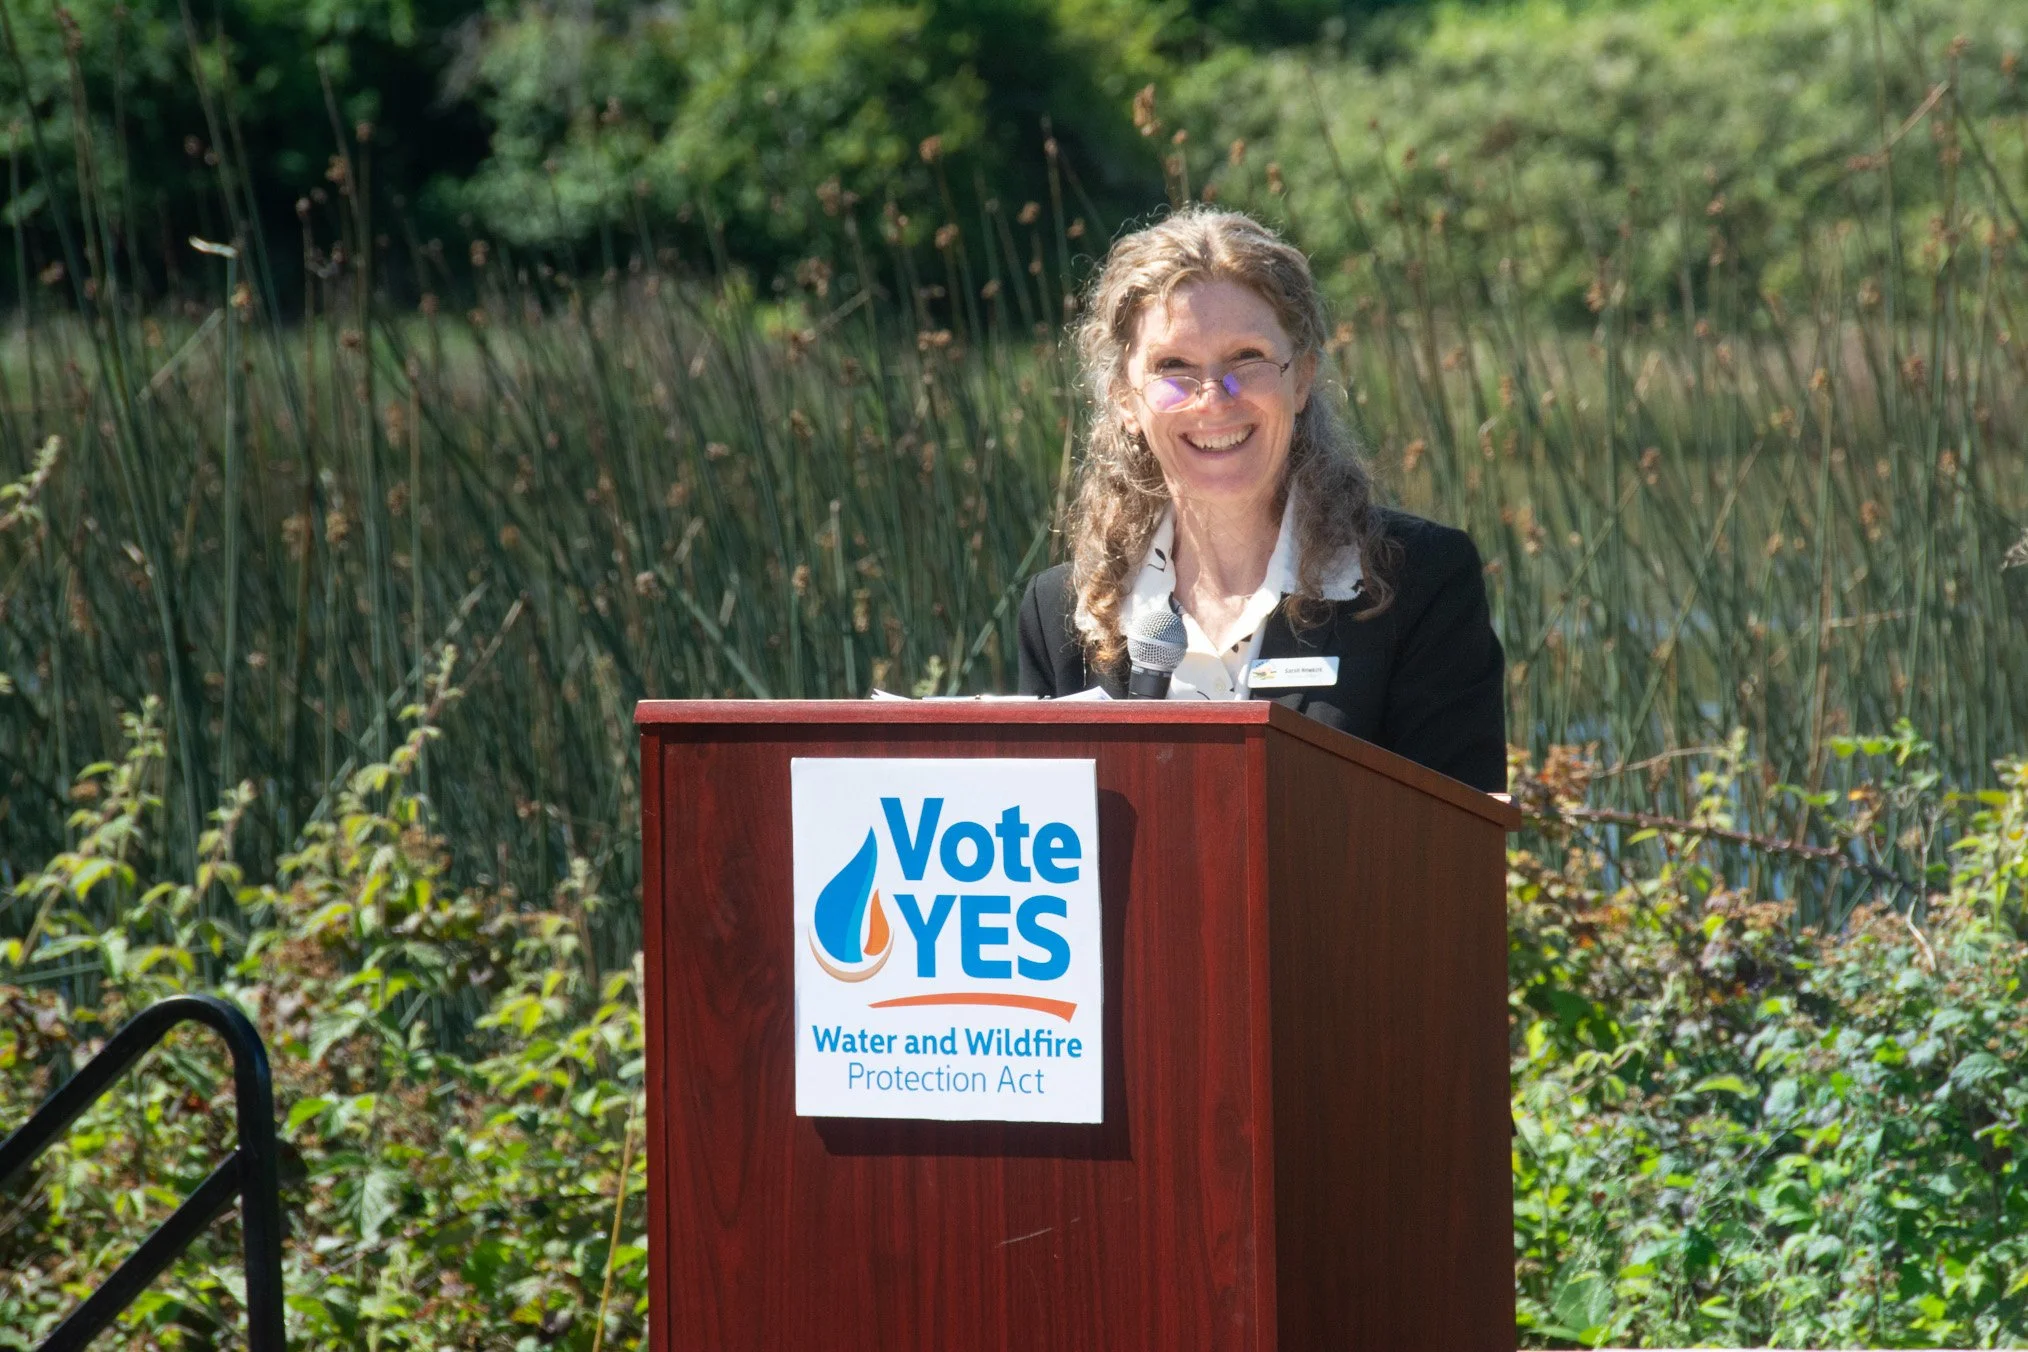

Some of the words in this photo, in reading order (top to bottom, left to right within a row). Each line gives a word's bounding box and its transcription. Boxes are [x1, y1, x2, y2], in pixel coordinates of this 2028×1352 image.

[880, 797, 1083, 884] Vote
[893, 893, 1071, 981] YES
[812, 1025, 898, 1055] Water
[904, 1027, 957, 1056] and
[964, 1027, 1083, 1058] Wildfire
[848, 1062, 987, 1092] Protection
[997, 1065, 1045, 1094] Act
